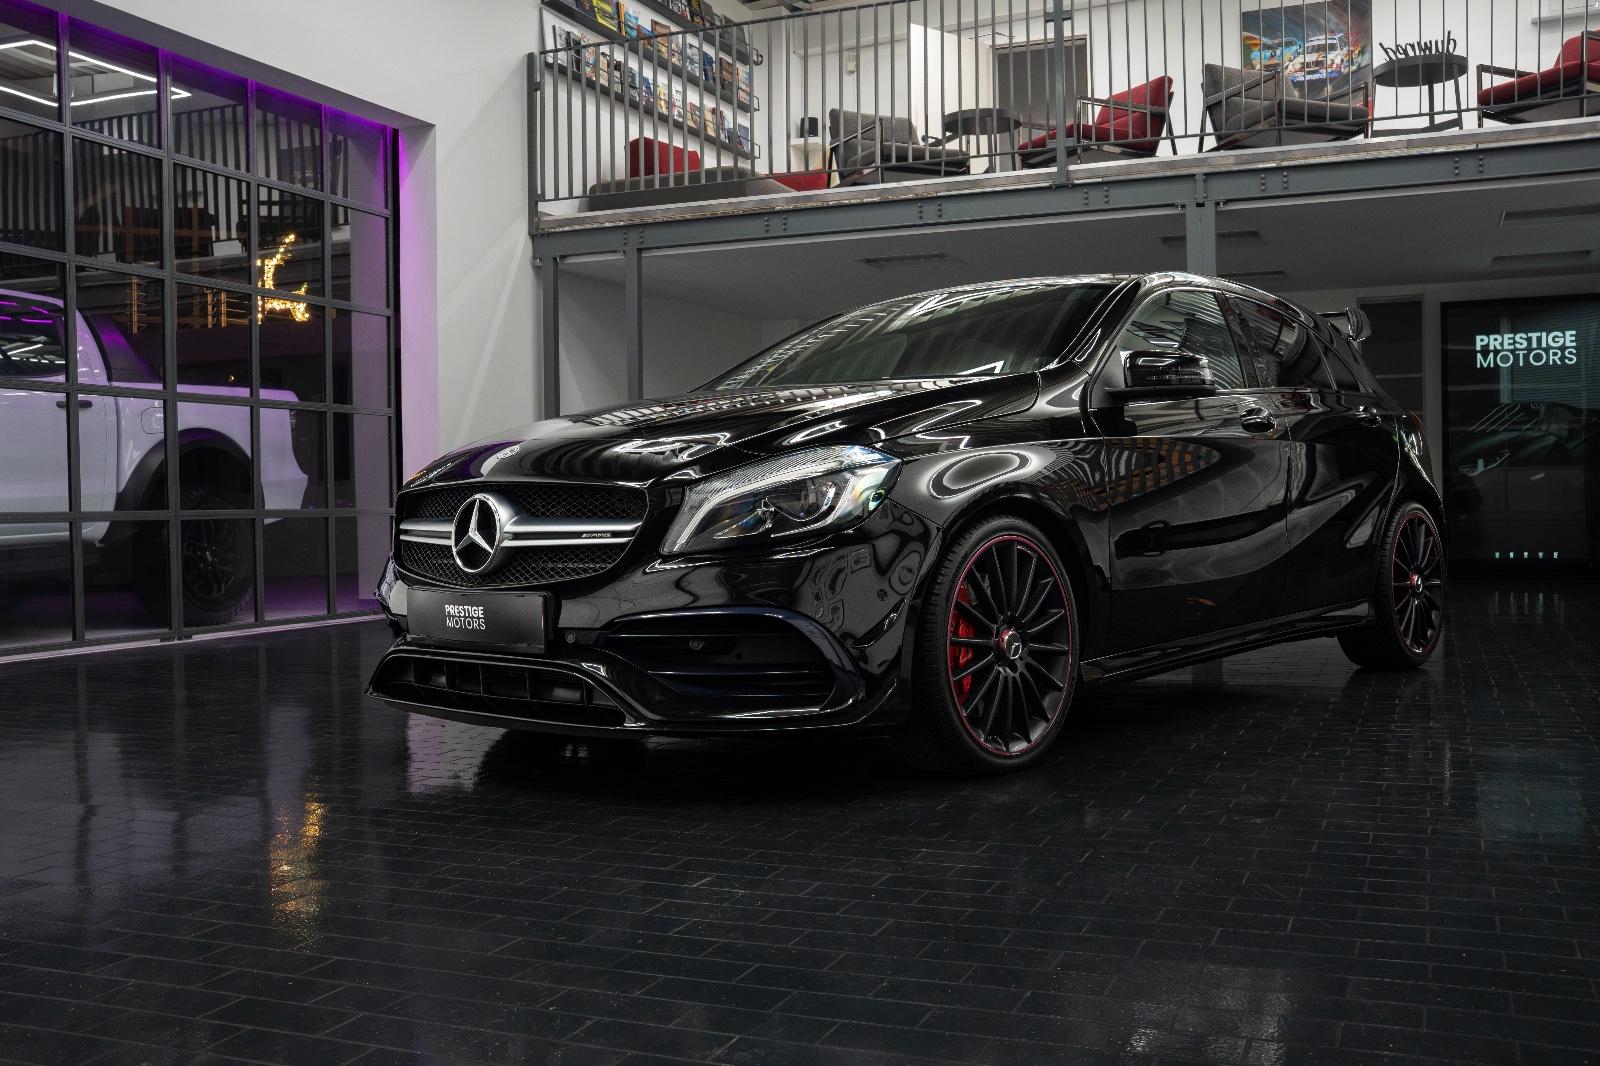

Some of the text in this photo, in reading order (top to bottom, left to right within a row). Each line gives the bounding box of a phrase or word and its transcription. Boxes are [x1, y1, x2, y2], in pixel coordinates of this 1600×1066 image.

[1475, 330, 1577, 350] PRESTIGE
[1476, 348, 1577, 368] MOTORS
[444, 604, 484, 618] PRESTIGE
[446, 616, 486, 630] MOTORS
